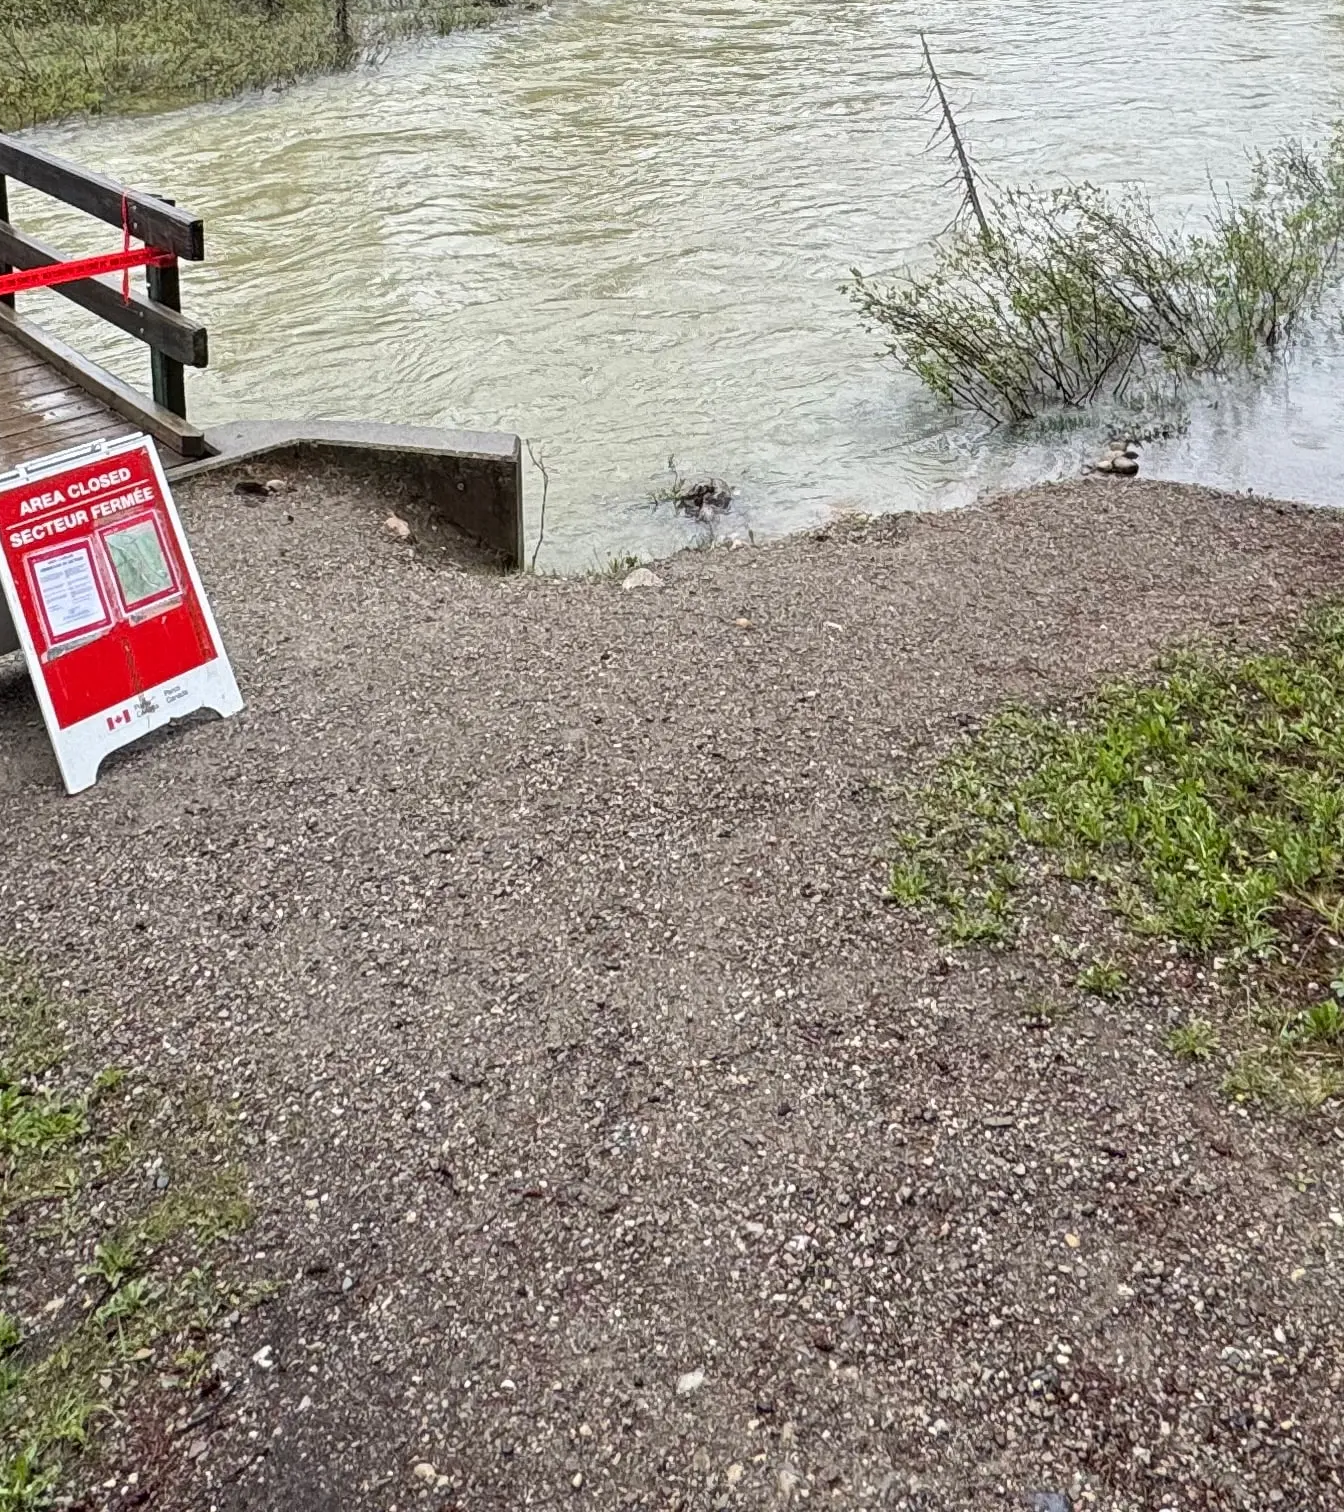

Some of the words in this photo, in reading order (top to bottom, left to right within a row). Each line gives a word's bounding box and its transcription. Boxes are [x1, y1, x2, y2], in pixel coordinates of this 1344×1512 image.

[9, 509, 89, 548] SECTEUR
[91, 485, 155, 520] FERMÉE
[20, 492, 66, 517] AREA
[67, 467, 131, 500] CLOSED
[166, 689, 189, 704] Canada
